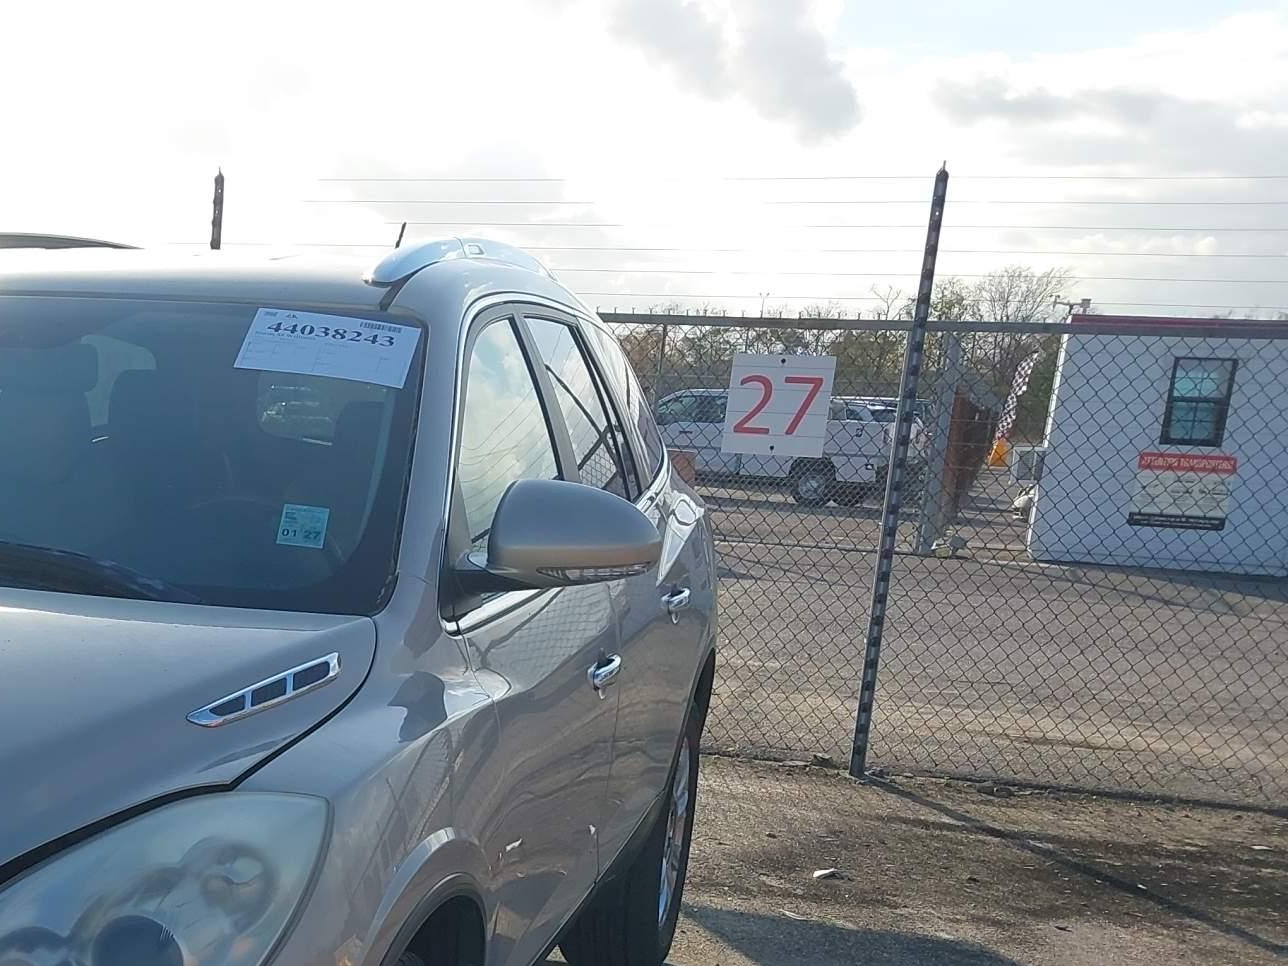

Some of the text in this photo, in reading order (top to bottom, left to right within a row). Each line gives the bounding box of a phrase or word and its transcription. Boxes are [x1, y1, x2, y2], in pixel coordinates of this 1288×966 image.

[267, 321, 395, 348] 44038243
[732, 374, 825, 436] 27
[281, 528, 297, 537] 01
